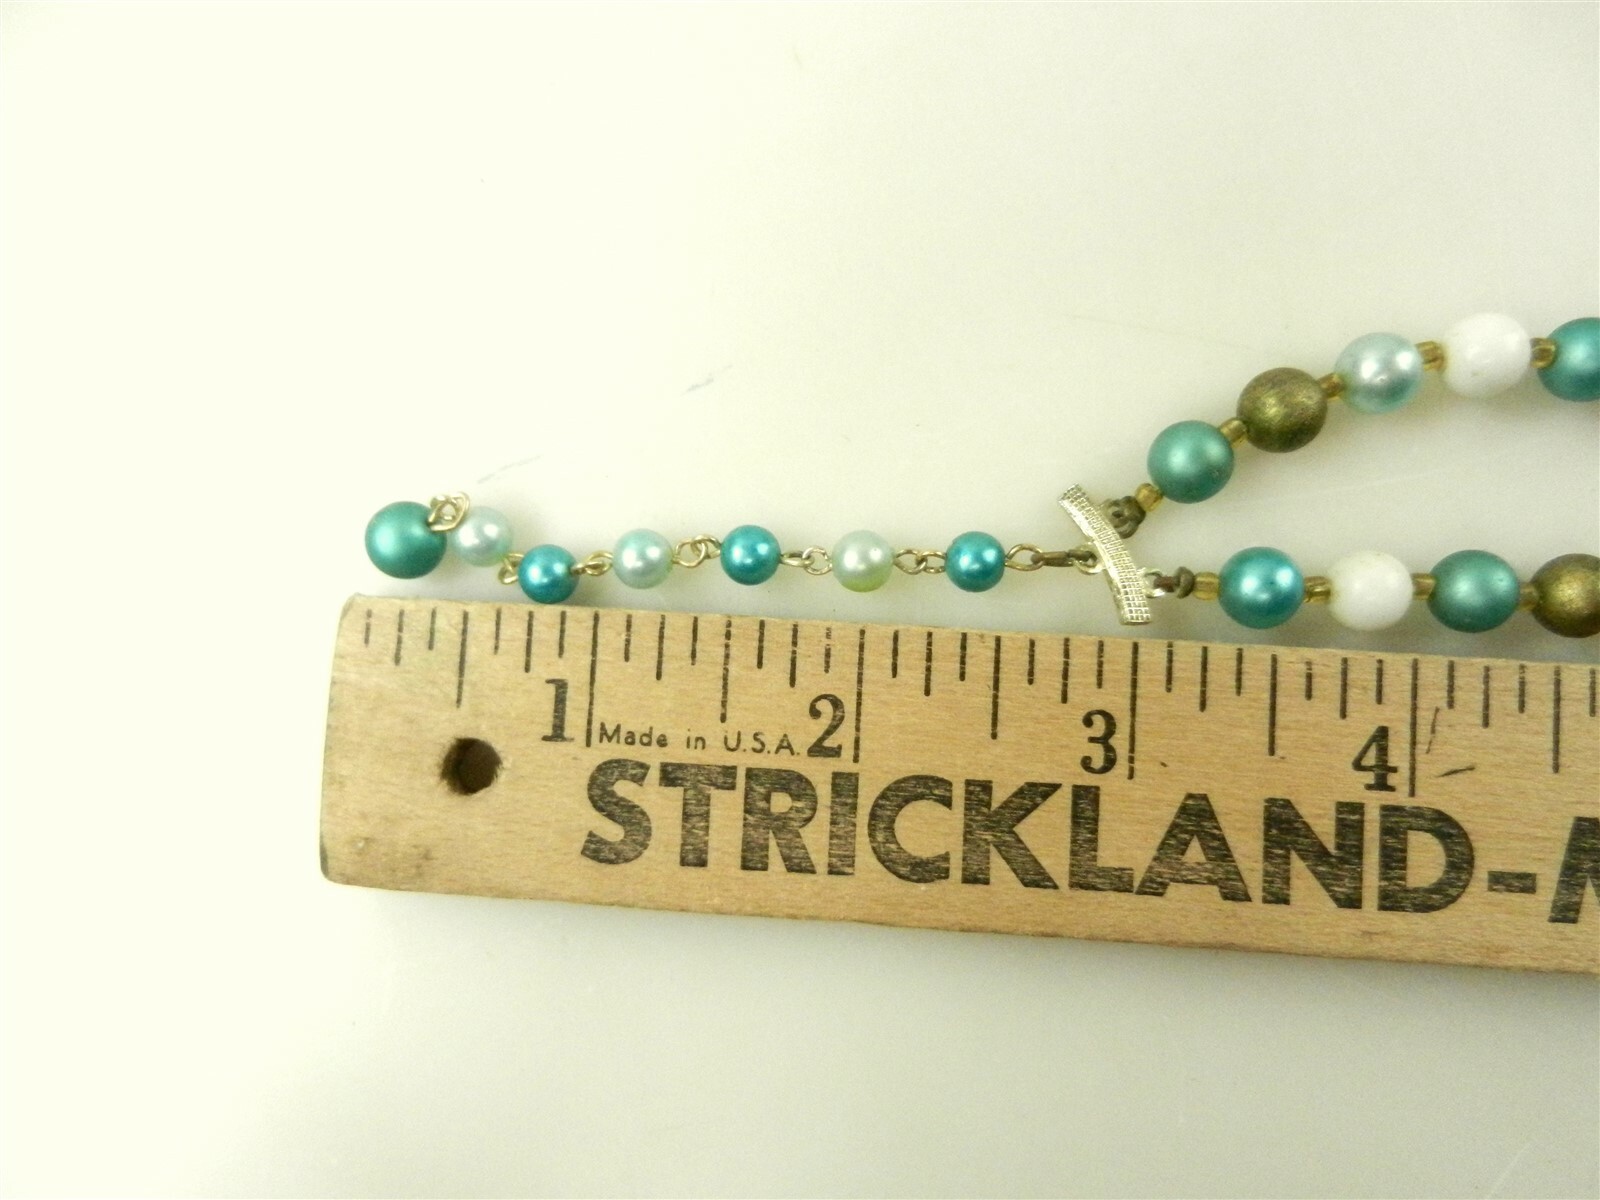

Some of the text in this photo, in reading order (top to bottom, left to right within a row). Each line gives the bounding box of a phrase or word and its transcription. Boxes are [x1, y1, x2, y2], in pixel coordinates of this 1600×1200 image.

[541, 678, 575, 743] 1
[599, 721, 800, 756] Made in U.S.A.
[807, 693, 845, 758] 2
[1080, 709, 1118, 774] 3
[1352, 726, 1398, 792] 4
